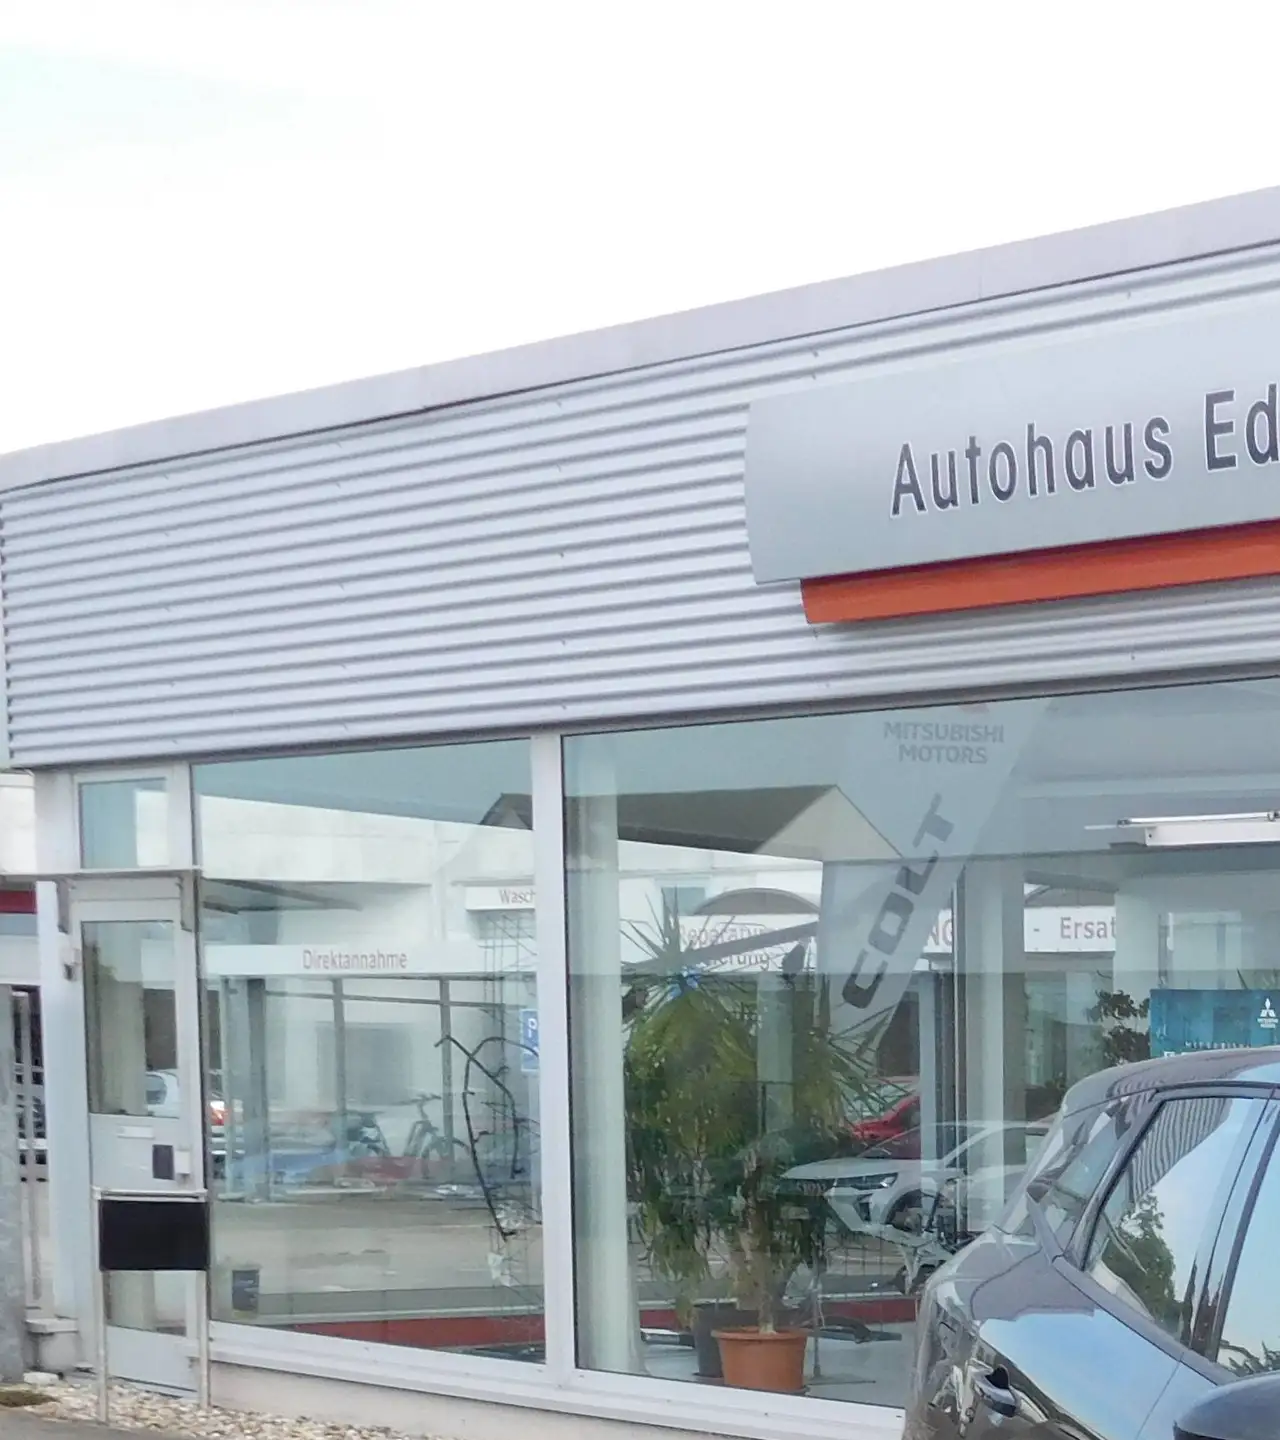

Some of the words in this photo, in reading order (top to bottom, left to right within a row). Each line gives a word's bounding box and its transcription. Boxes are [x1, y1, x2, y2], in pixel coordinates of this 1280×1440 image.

[889, 408, 1173, 518] Autohaus
[883, 720, 1005, 743] MITSUBISHI
[898, 744, 989, 764] MOTORS
[840, 792, 956, 1010] COLT
[302, 949, 408, 970] Direktannahme
